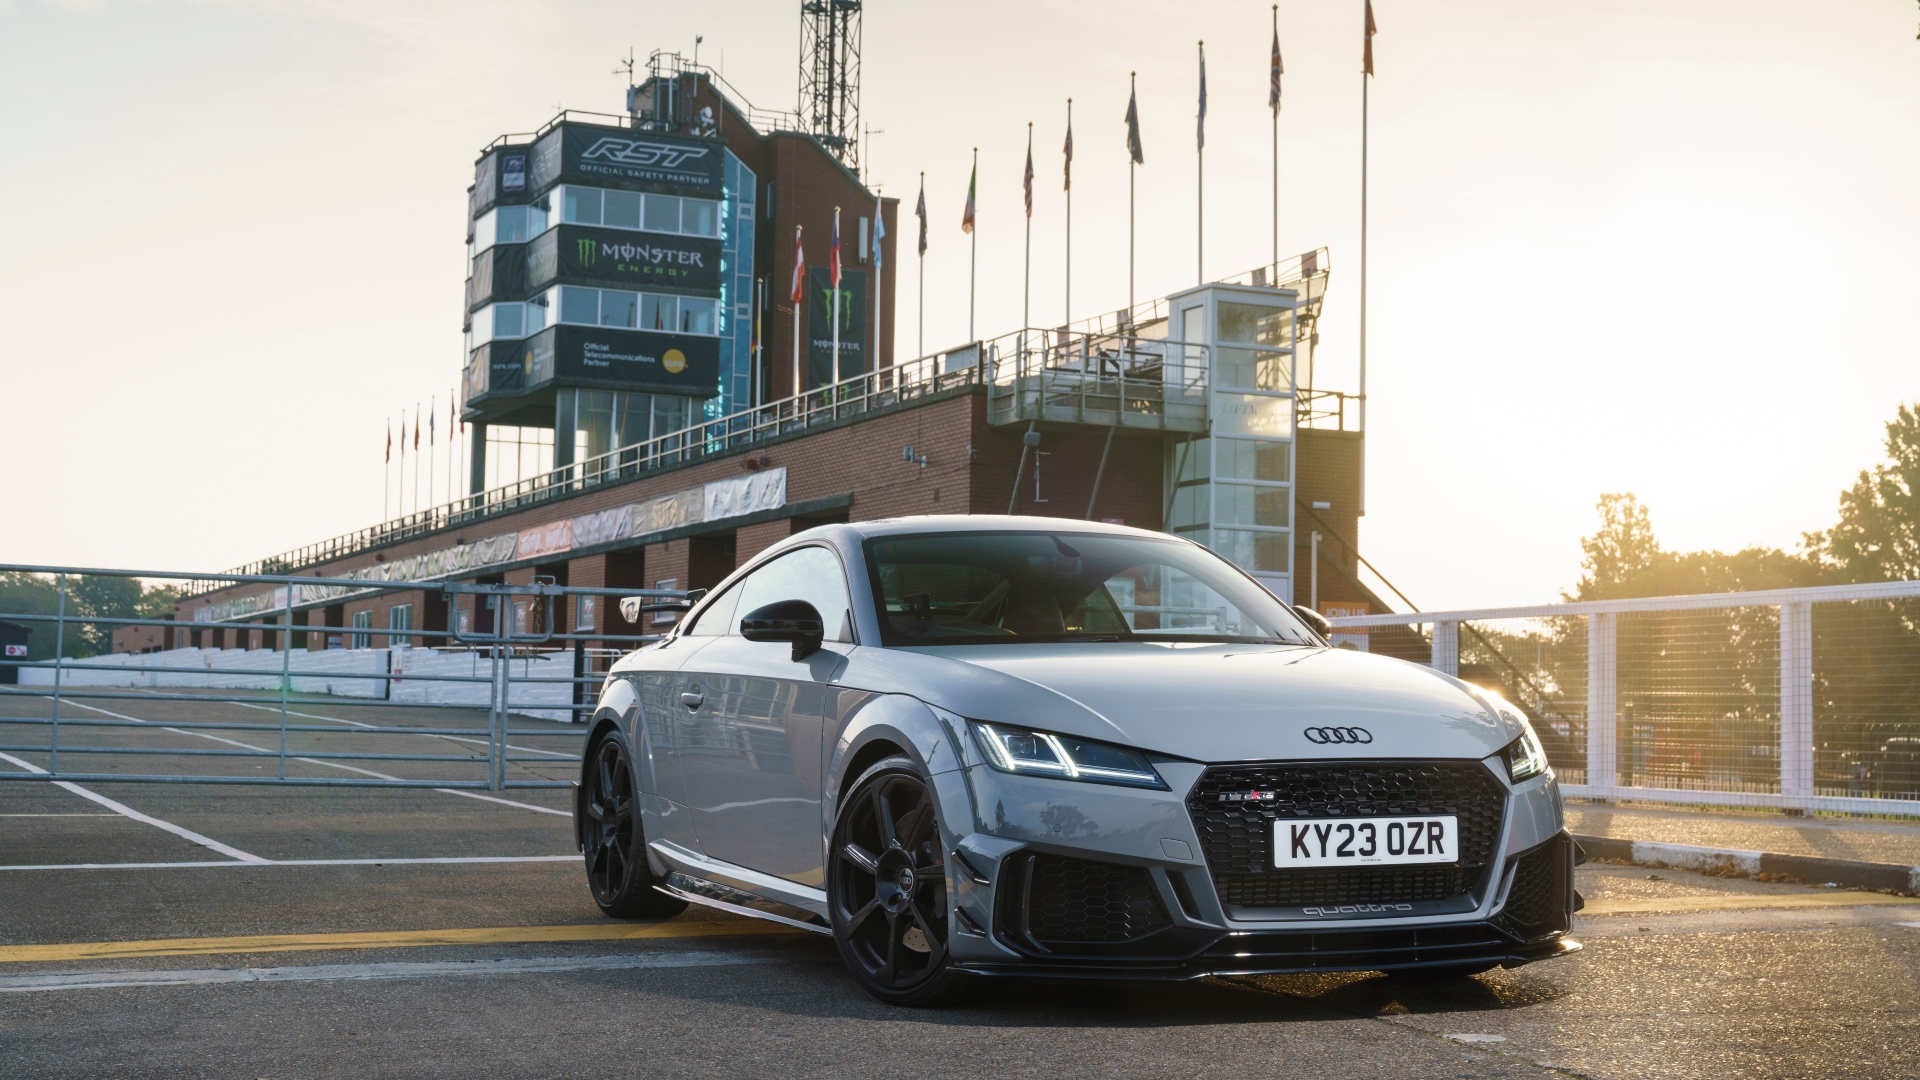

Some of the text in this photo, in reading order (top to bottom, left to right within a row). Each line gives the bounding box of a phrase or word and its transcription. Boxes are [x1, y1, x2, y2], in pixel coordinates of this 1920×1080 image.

[582, 137, 709, 168] RST
[580, 164, 710, 185] OFFICIAL SAFETY PARTNER
[602, 242, 704, 268] MONSTER
[618, 264, 688, 277] ENERGY
[583, 342, 609, 352] Official
[583, 350, 656, 363] Telecommunications
[583, 358, 610, 367] Partner
[1325, 607, 1350, 618] JOIN
[1291, 821, 1444, 858] KY23 OZR
[1303, 904, 1413, 917] quattro
